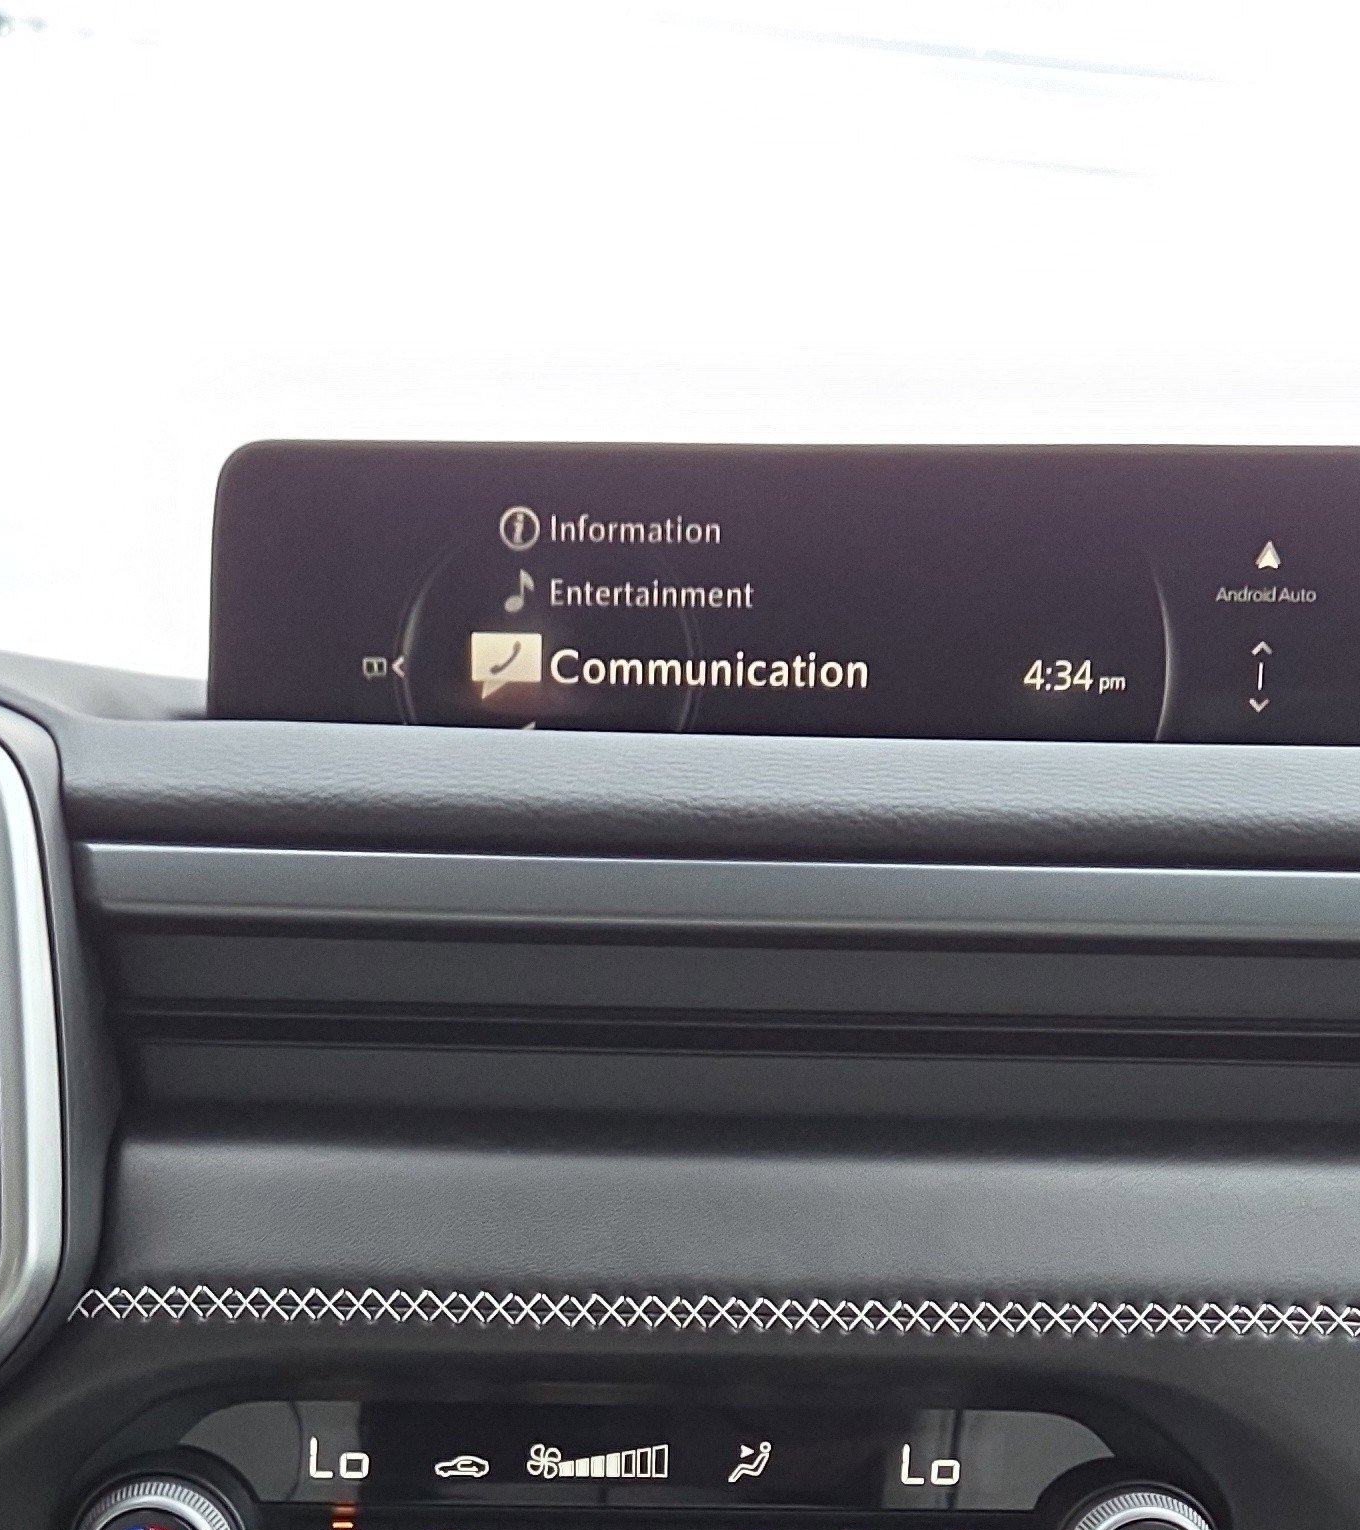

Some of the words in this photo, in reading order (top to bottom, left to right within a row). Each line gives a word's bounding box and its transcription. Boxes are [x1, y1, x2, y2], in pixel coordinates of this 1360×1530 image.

[551, 514, 721, 544] Information
[550, 578, 754, 609] Entertainment
[1216, 586, 1276, 603] Android
[1278, 587, 1317, 603] Auto
[550, 649, 868, 689] Communication
[1023, 659, 1093, 691] 4:34
[1099, 675, 1126, 694] pm
[309, 1437, 370, 1480] Lo
[900, 1444, 961, 1485] Lo
